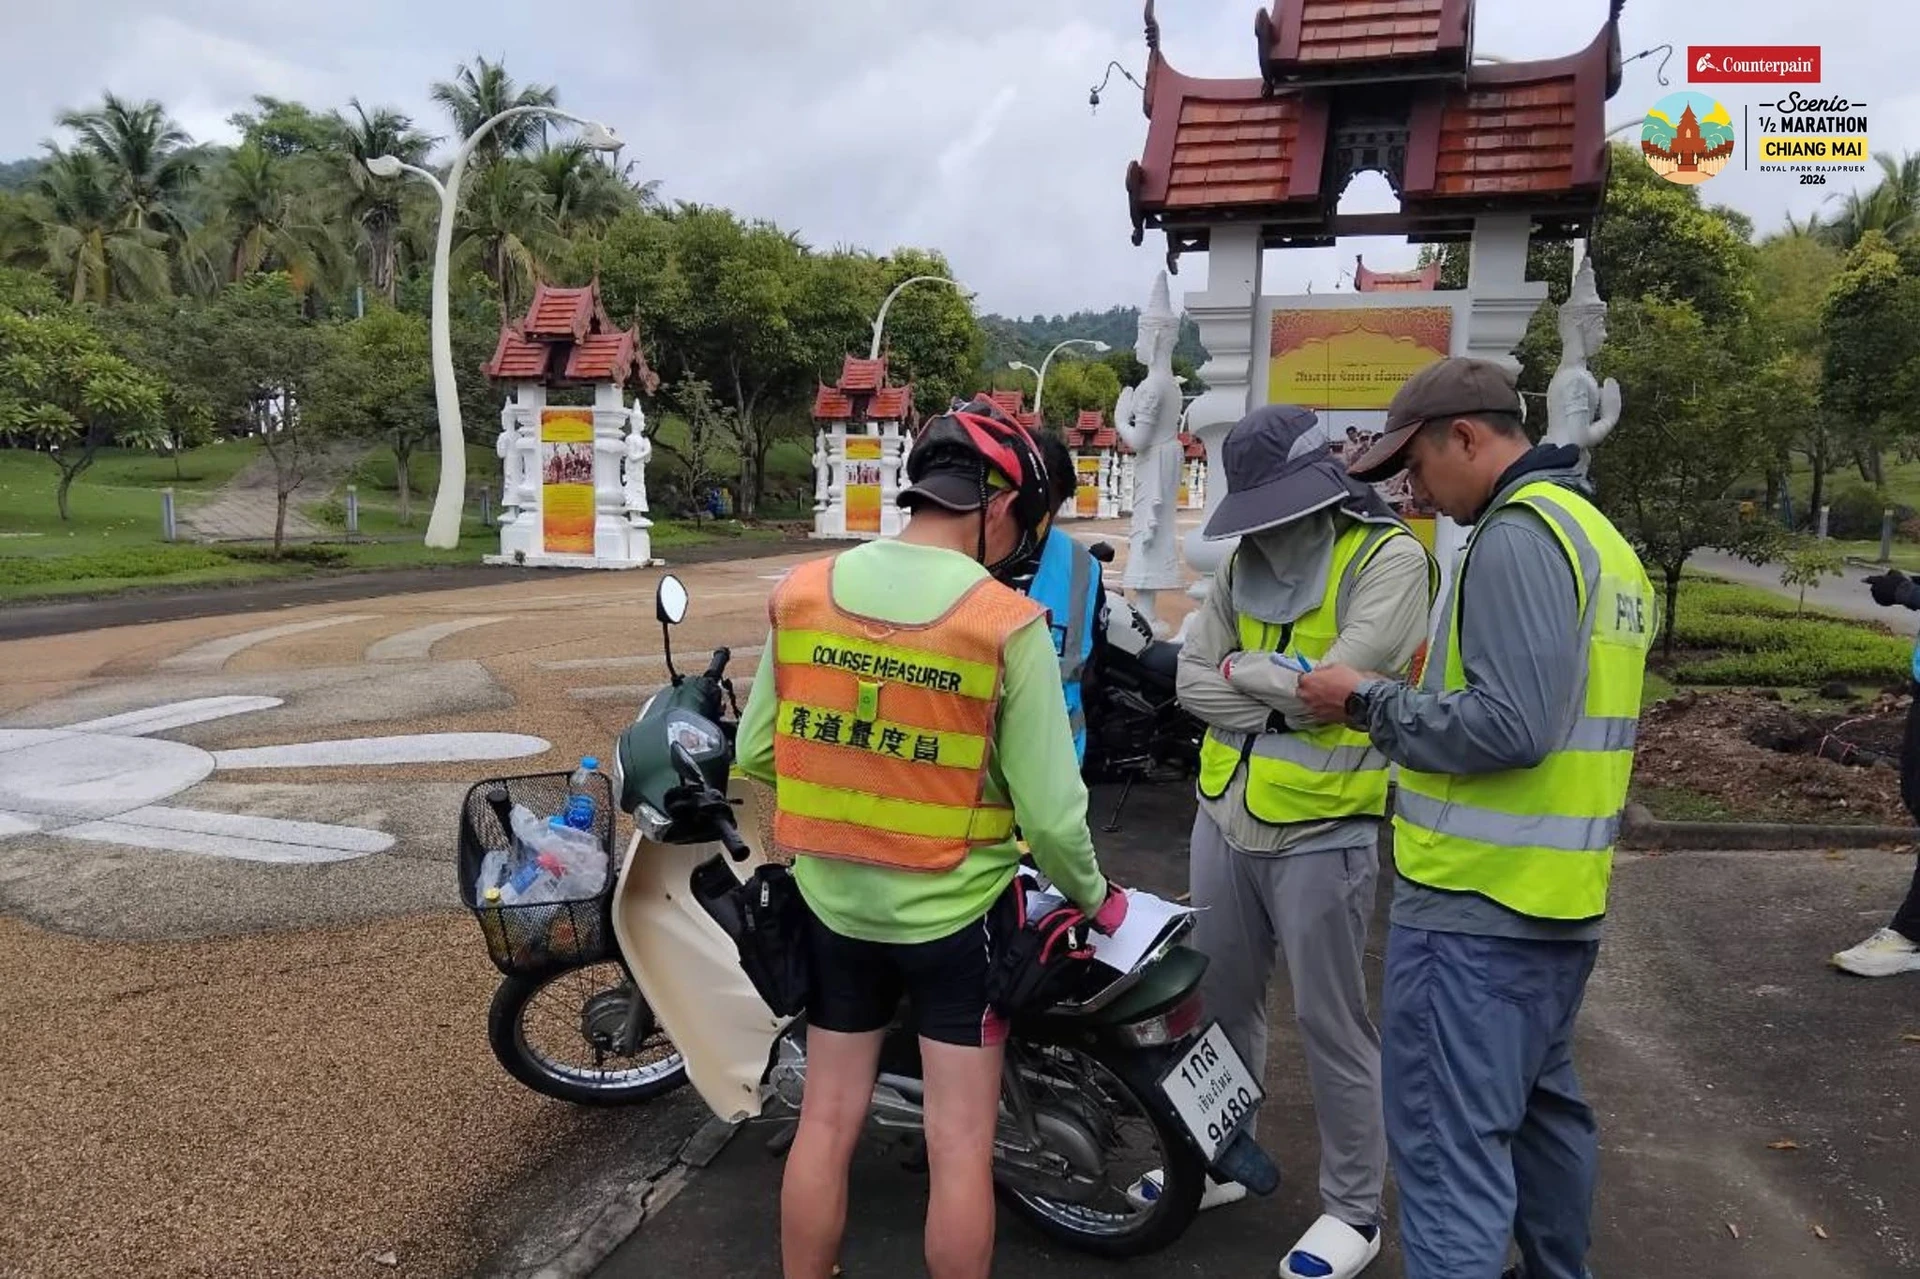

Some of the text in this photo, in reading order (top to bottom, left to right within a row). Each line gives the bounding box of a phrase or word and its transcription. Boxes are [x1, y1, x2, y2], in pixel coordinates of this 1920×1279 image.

[813, 645, 962, 692] COURSE MEASURER
[1208, 1086, 1251, 1147] 9480
